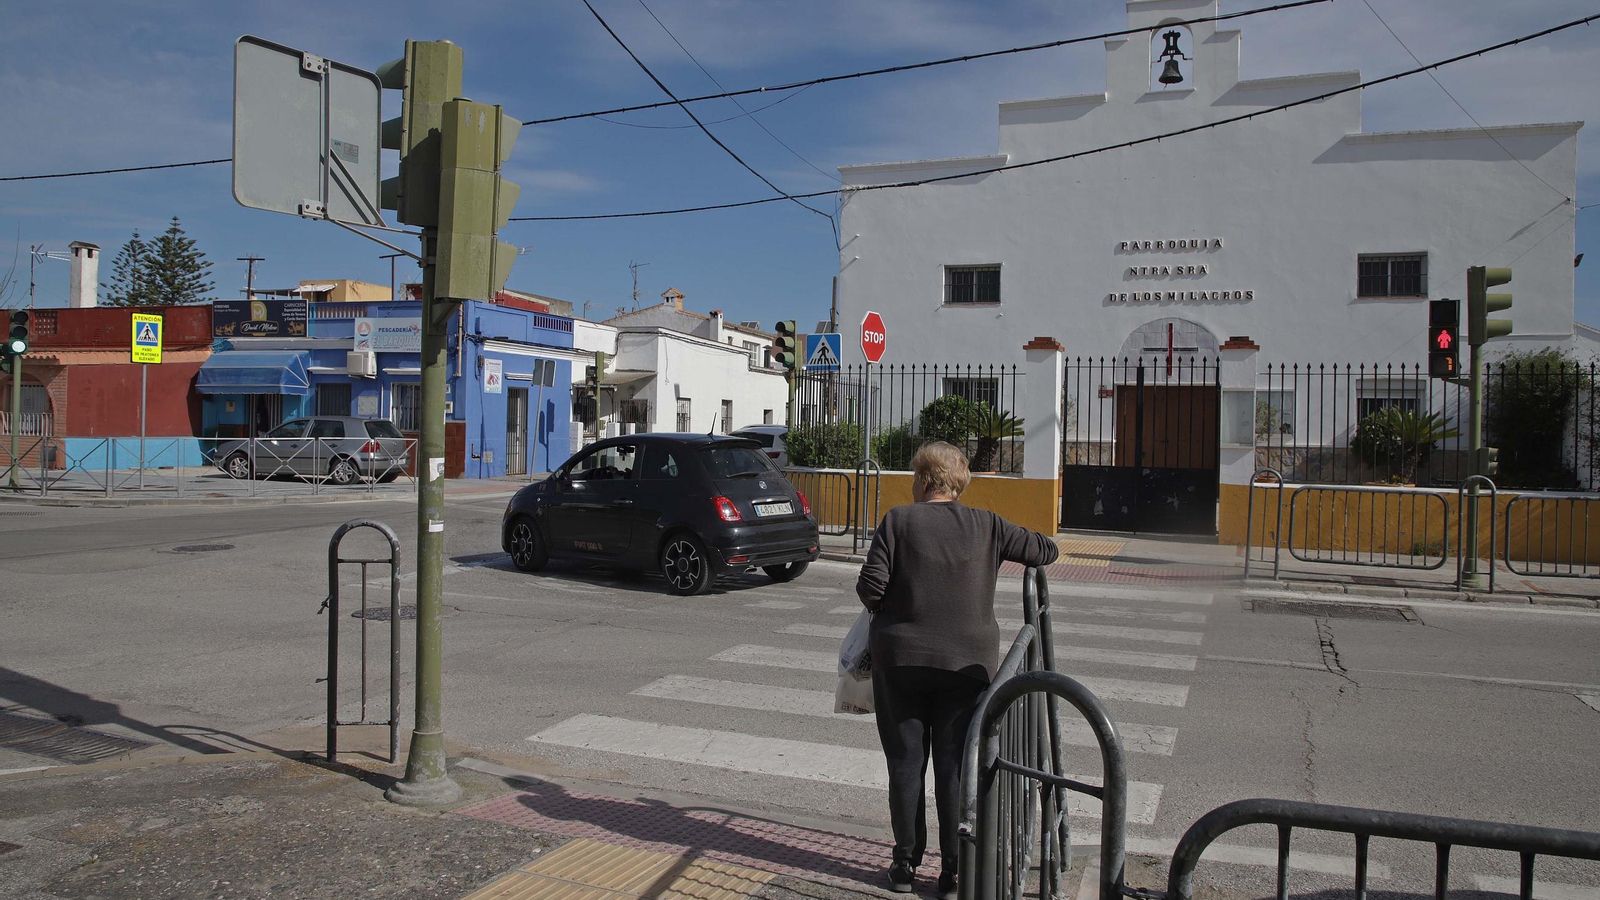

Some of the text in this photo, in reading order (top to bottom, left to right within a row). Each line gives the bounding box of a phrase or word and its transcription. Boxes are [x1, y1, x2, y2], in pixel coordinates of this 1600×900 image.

[1121, 239, 1223, 251] PARROQUIA
[1129, 264, 1208, 276] NTRA SRA
[864, 330, 884, 344] STOP
